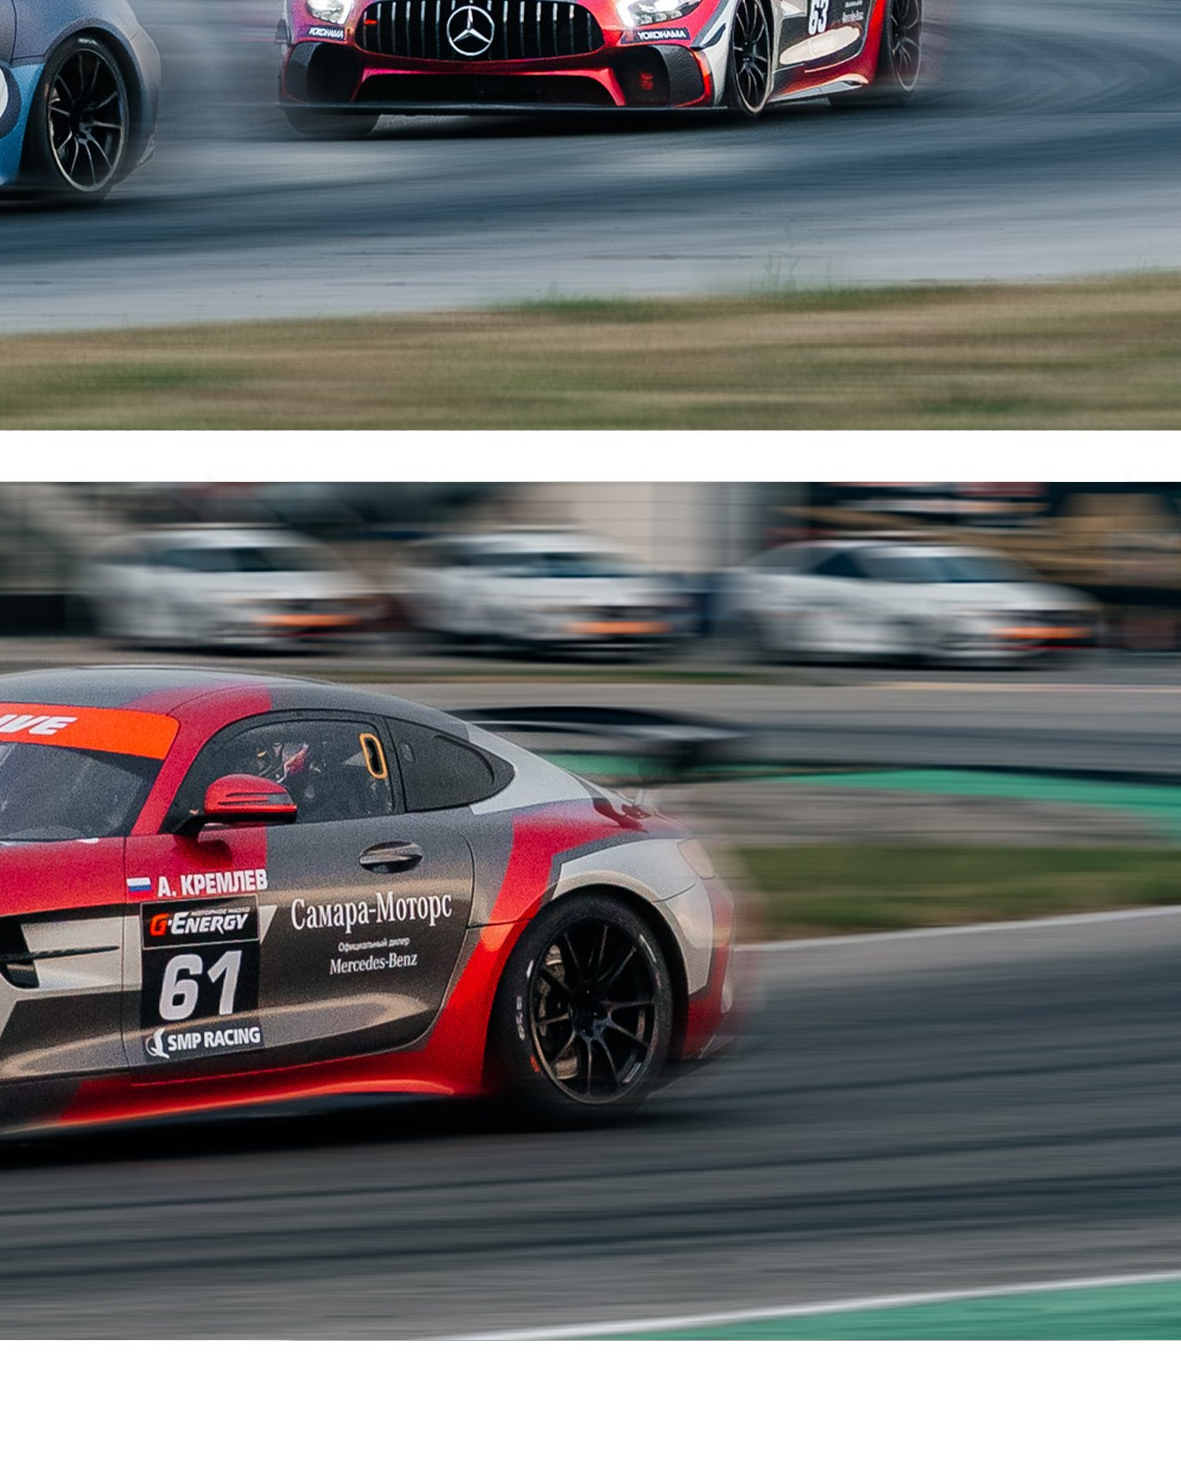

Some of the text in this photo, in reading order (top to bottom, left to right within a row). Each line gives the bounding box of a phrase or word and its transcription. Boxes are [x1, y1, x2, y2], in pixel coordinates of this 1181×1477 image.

[637, 29, 688, 41] YOKOHAMA
[158, 868, 269, 898] А. КРЕМЛЕВ
[290, 890, 453, 935] Самара-Моторс
[329, 952, 418, 976] Mercedes-Benz
[158, 950, 243, 1022] 61
[167, 1026, 262, 1052] SMP RACING
